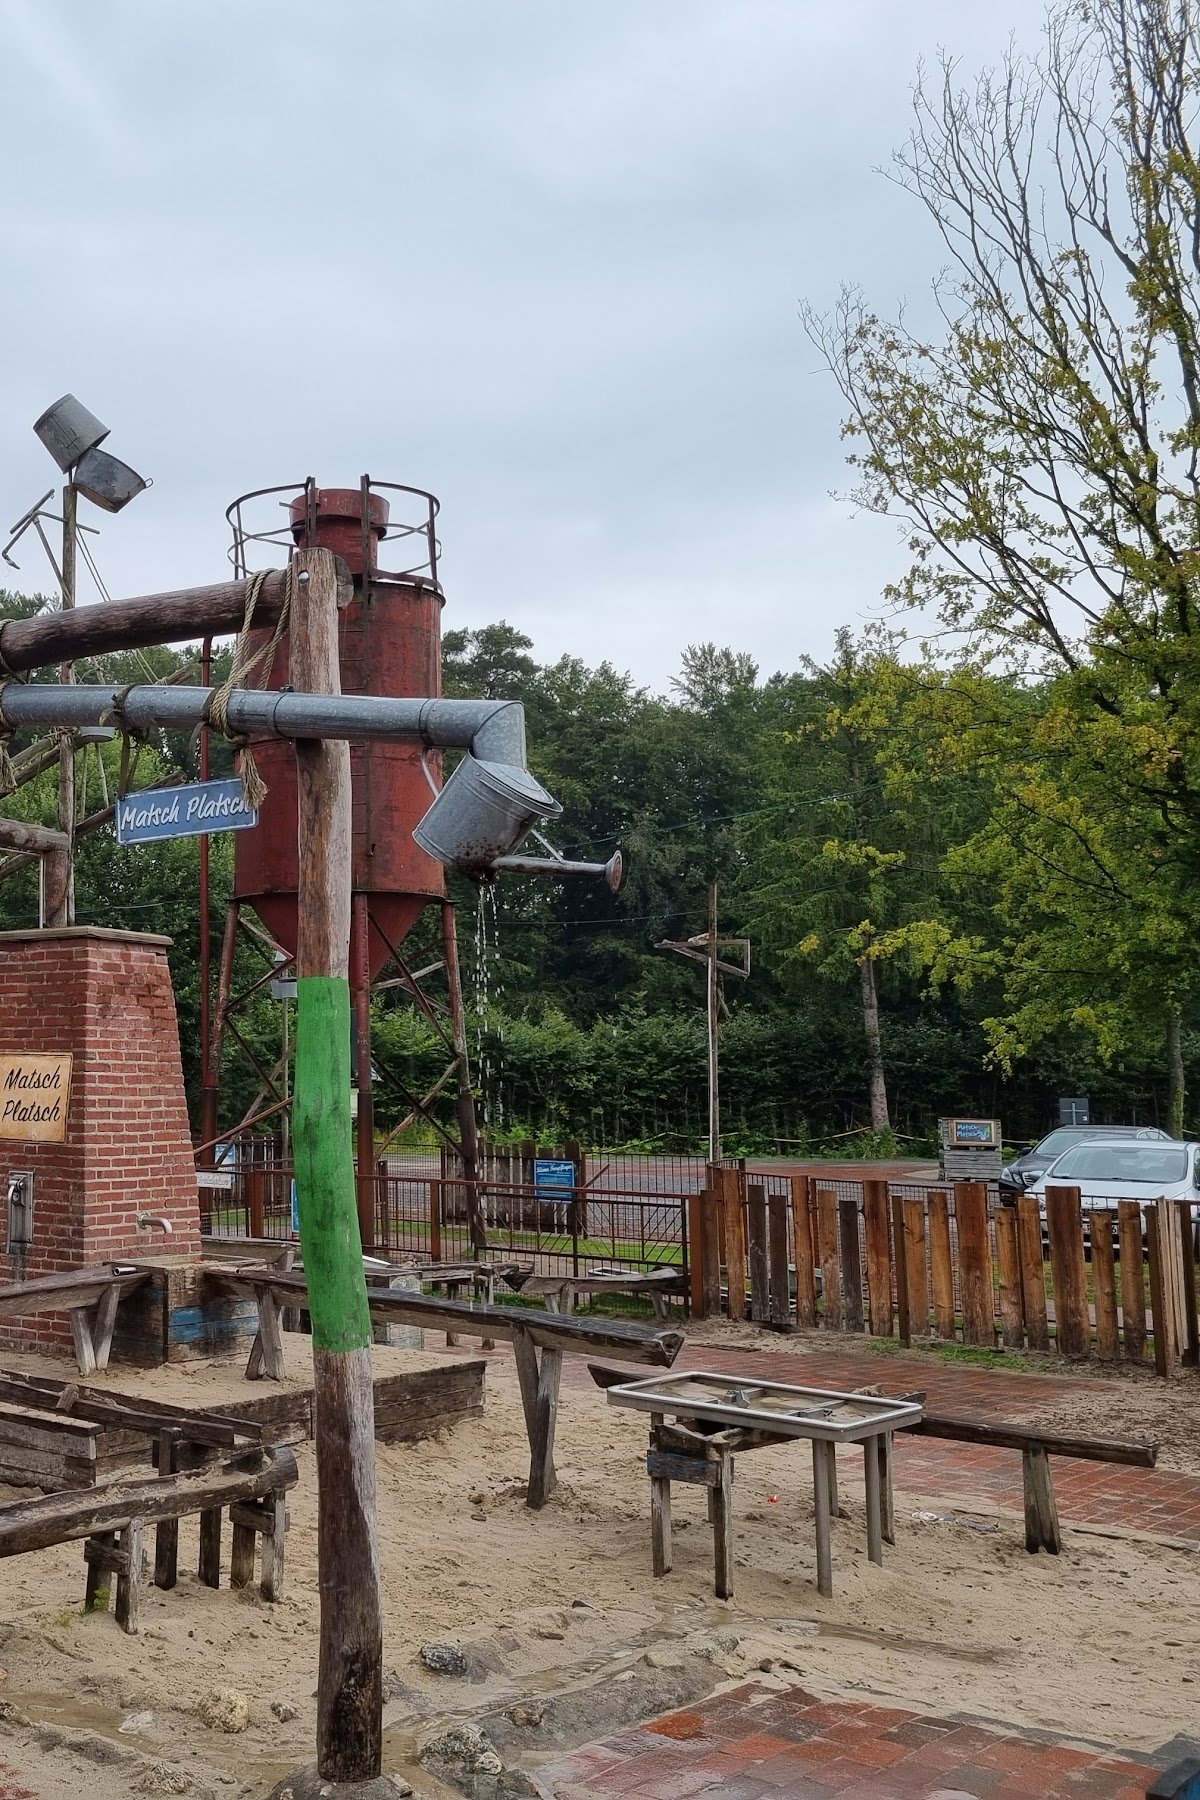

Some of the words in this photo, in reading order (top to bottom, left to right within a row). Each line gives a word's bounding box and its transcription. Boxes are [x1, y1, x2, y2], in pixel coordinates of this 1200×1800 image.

[121, 796, 179, 831] Matsch
[4, 1064, 62, 1090] Matsch
[2, 1096, 62, 1122] Platsch
